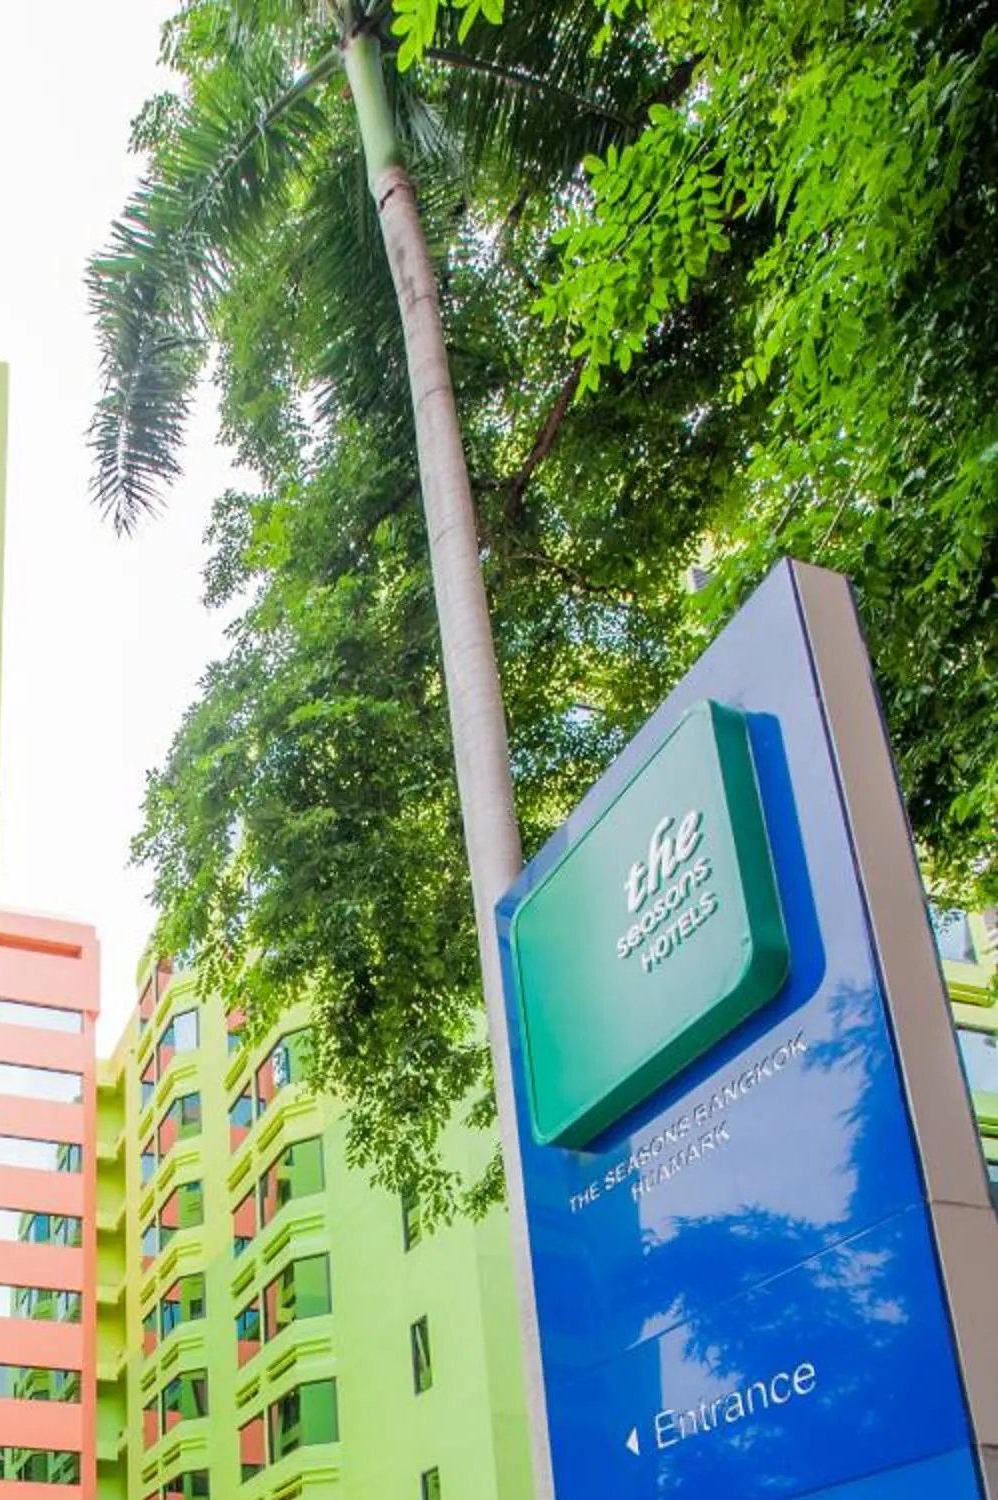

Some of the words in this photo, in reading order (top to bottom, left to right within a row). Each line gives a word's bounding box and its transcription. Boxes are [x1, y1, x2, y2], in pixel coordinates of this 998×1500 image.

[623, 809, 700, 914] the
[640, 891, 717, 973] HOTELS
[569, 1180, 601, 1214] THE
[603, 1115, 691, 1192] SEASONS
[693, 1028, 808, 1127] BANGKOK
[630, 1120, 730, 1203] HUAMARK
[654, 1361, 817, 1450] Entrance
